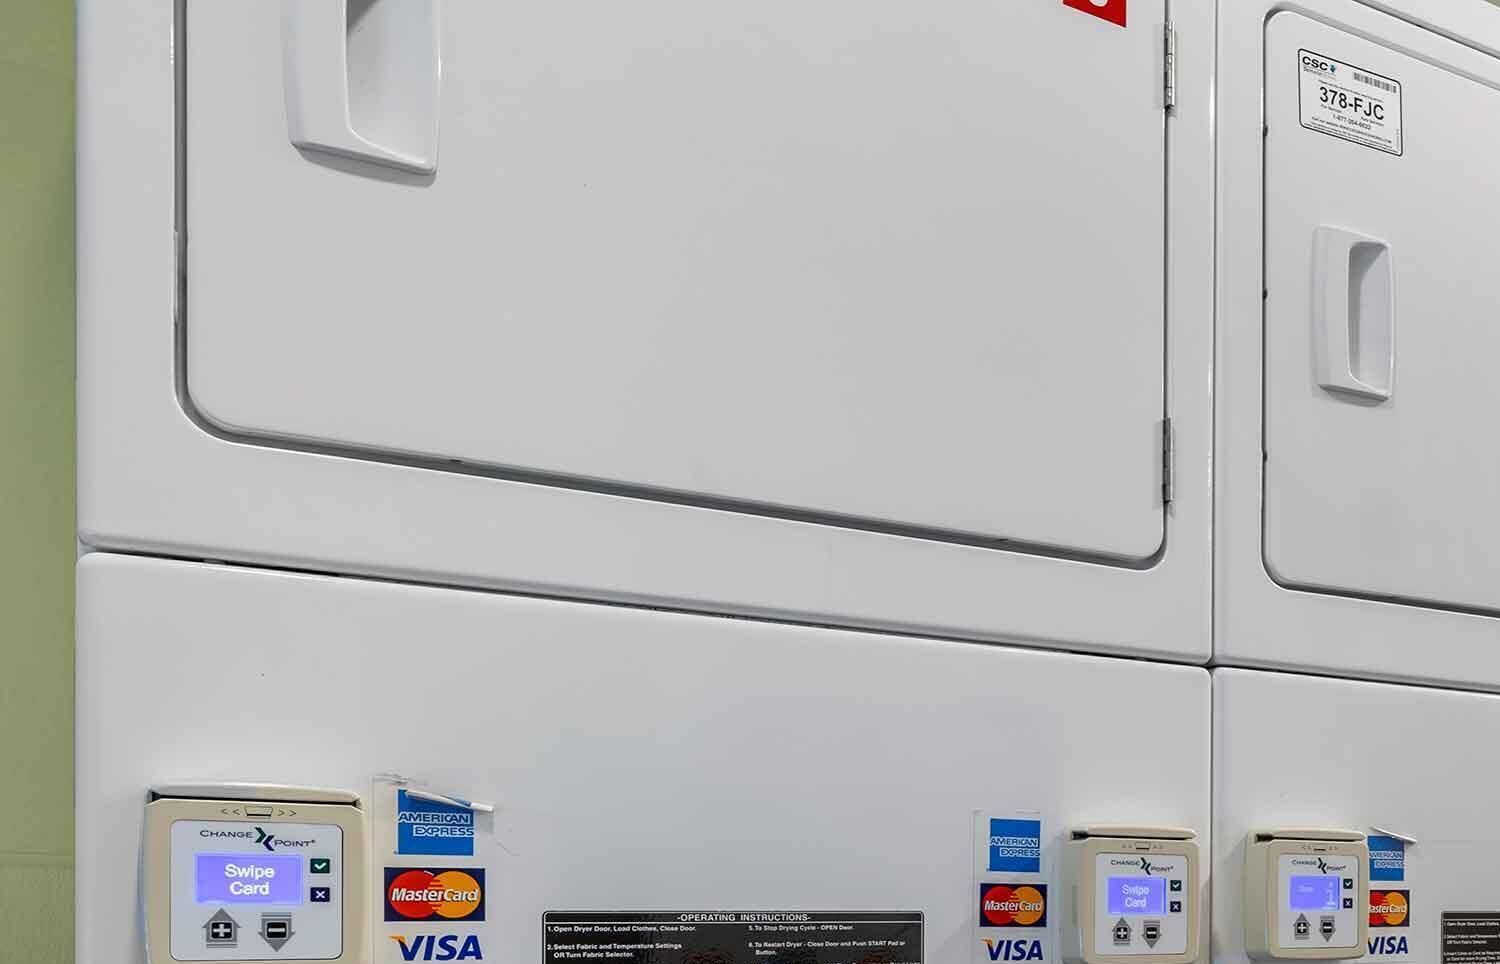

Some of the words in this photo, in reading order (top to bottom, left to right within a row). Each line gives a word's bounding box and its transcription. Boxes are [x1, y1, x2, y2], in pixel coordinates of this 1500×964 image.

[1302, 56, 1329, 71] CSC
[1320, 86, 1384, 120] 378-FJC
[398, 812, 472, 824] AMERICAN
[200, 830, 254, 838] CHANGE
[413, 825, 475, 837] EXPRESS
[990, 836, 1039, 847] AMERICAN
[1000, 848, 1040, 857] EXPRESS
[224, 863, 275, 880] Swipe
[229, 881, 270, 895] Card
[391, 887, 479, 903] MasterCard
[984, 899, 1043, 912] MasterCard
[1125, 896, 1147, 908] Card
[390, 935, 483, 961] VISA
[982, 939, 1044, 961] VISA
[1368, 936, 1409, 955] VISA
